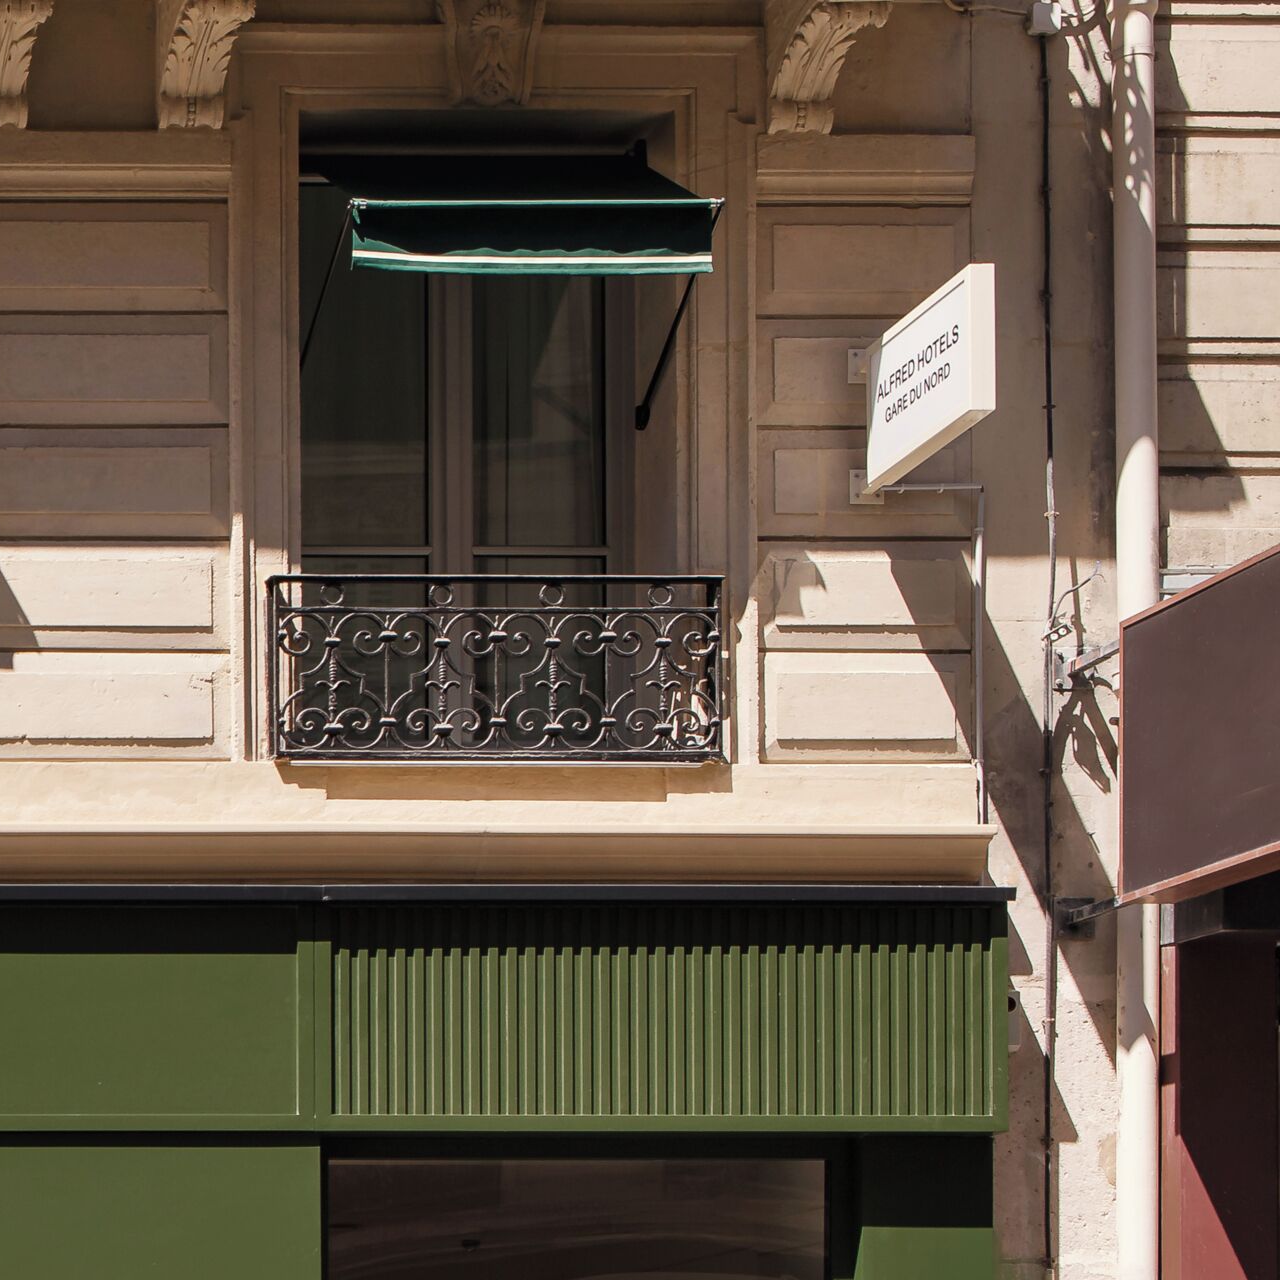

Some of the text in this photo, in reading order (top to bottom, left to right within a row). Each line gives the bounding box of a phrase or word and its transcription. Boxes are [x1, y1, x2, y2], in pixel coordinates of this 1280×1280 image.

[877, 324, 960, 403] ALFRED HOTELS
[885, 362, 951, 423] GARE DU NORD
